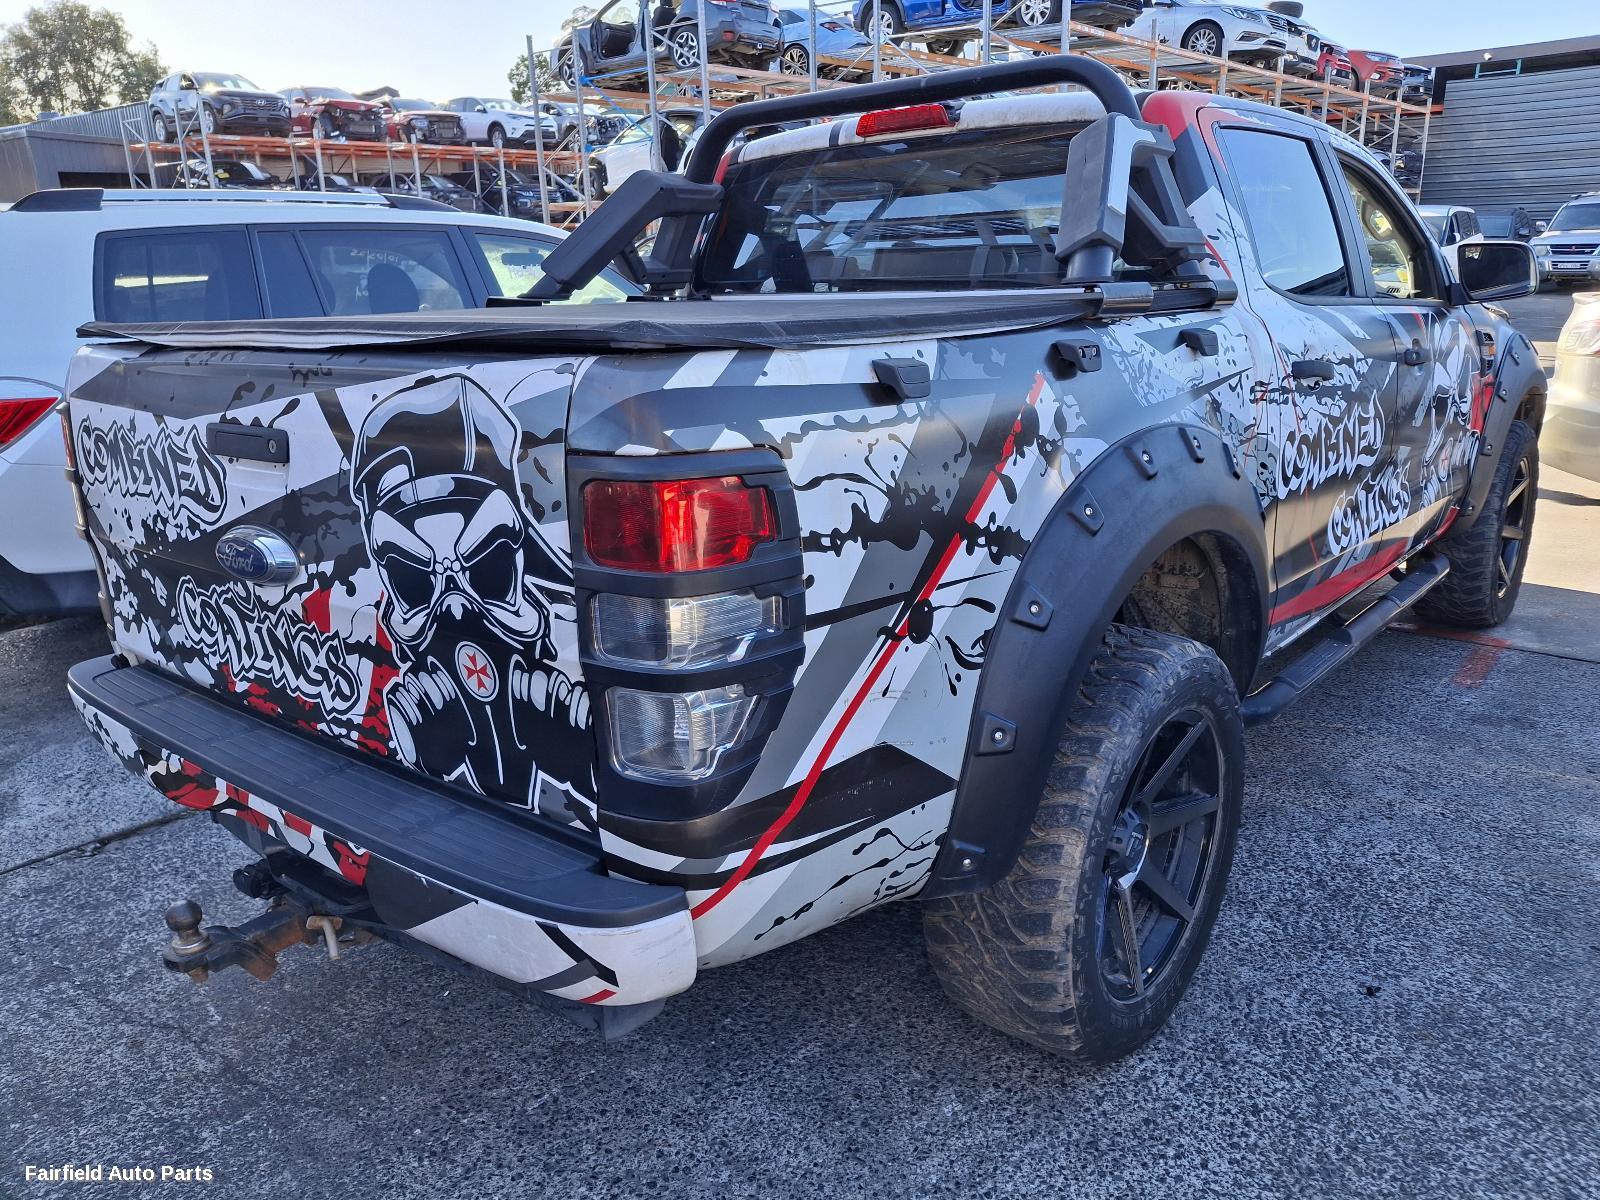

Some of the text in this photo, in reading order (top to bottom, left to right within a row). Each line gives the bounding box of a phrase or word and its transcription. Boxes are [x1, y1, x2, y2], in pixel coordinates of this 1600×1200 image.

[77, 414, 227, 525] COMBINED
[1276, 389, 1386, 499] COMBINED
[219, 543, 254, 572] Ford
[177, 576, 361, 719] COATINGS
